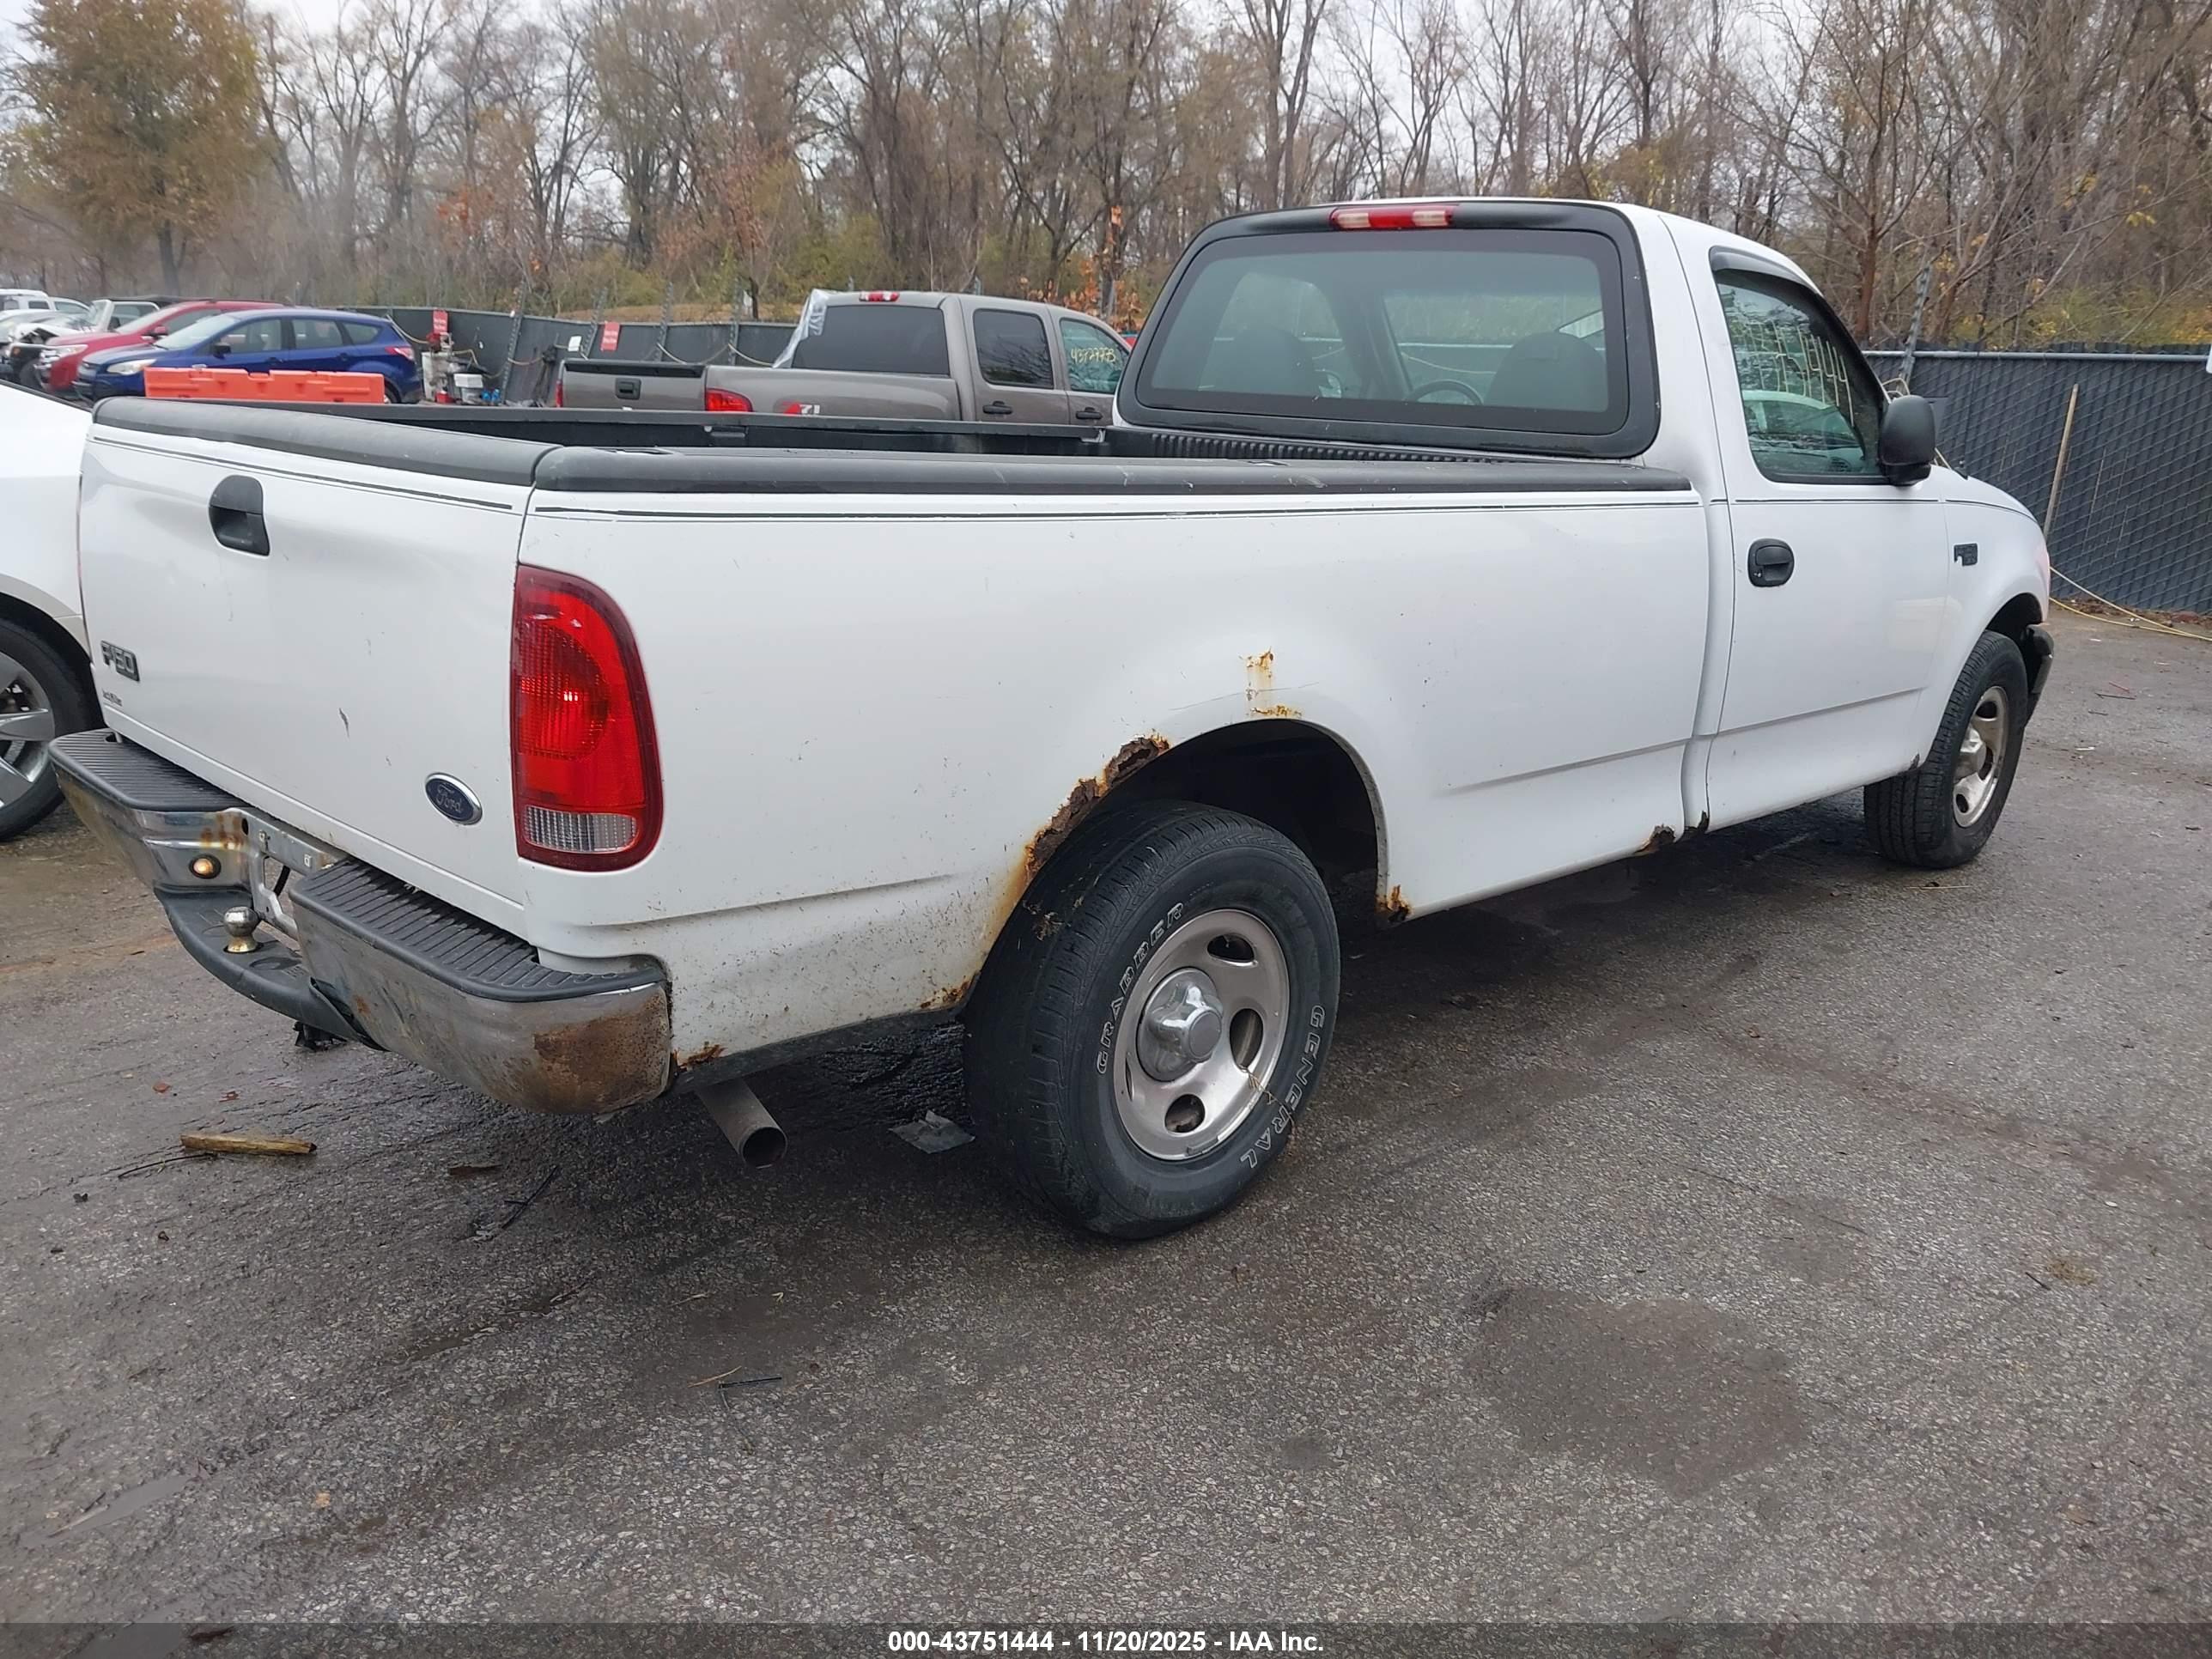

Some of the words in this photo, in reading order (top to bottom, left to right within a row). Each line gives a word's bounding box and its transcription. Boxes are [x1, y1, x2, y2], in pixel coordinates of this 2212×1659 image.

[435, 783, 464, 814] Ford
[1097, 902, 1184, 1074] GRABBER
[1240, 1005, 1326, 1169] GENERAL
